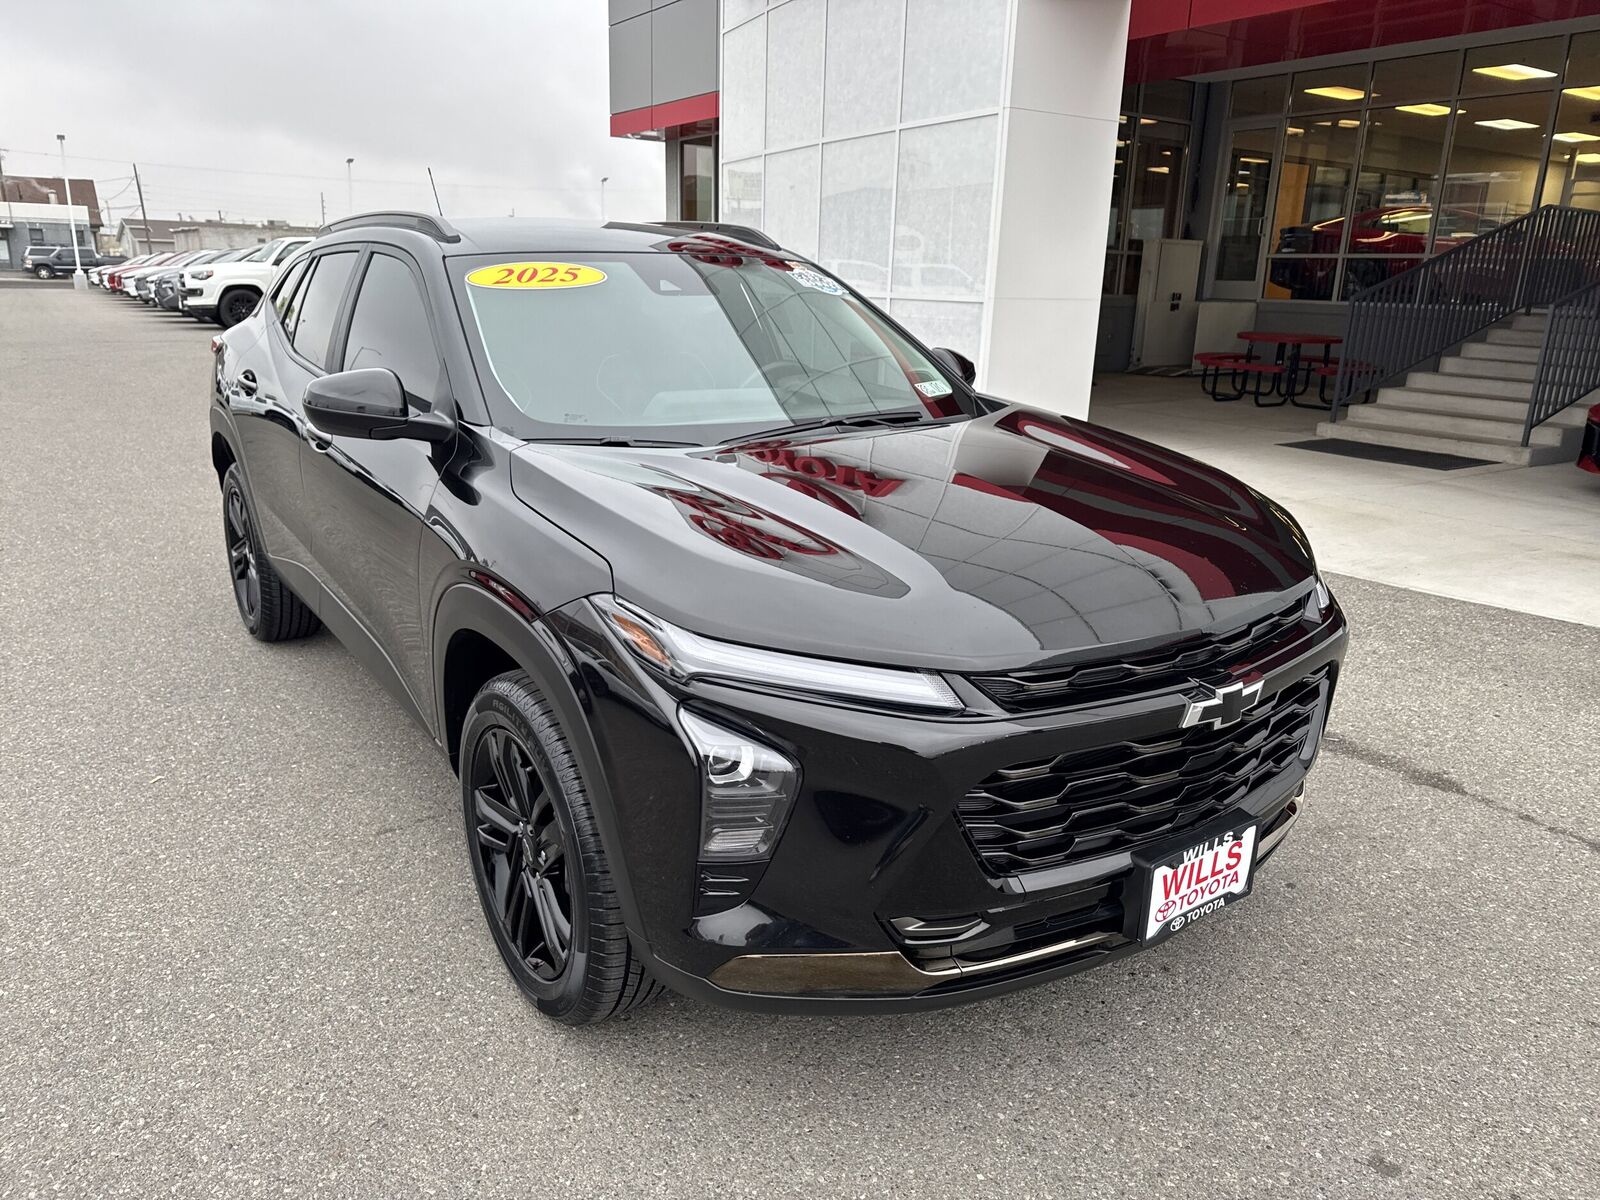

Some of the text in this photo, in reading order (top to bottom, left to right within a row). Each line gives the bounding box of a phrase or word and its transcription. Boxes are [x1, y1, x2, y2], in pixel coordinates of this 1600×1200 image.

[492, 267, 582, 285] 2025
[1183, 831, 1234, 864] WILLS
[1162, 840, 1243, 900] WILLS
[1178, 870, 1239, 910] TOYOTA
[1186, 897, 1225, 923] TOYOTA
